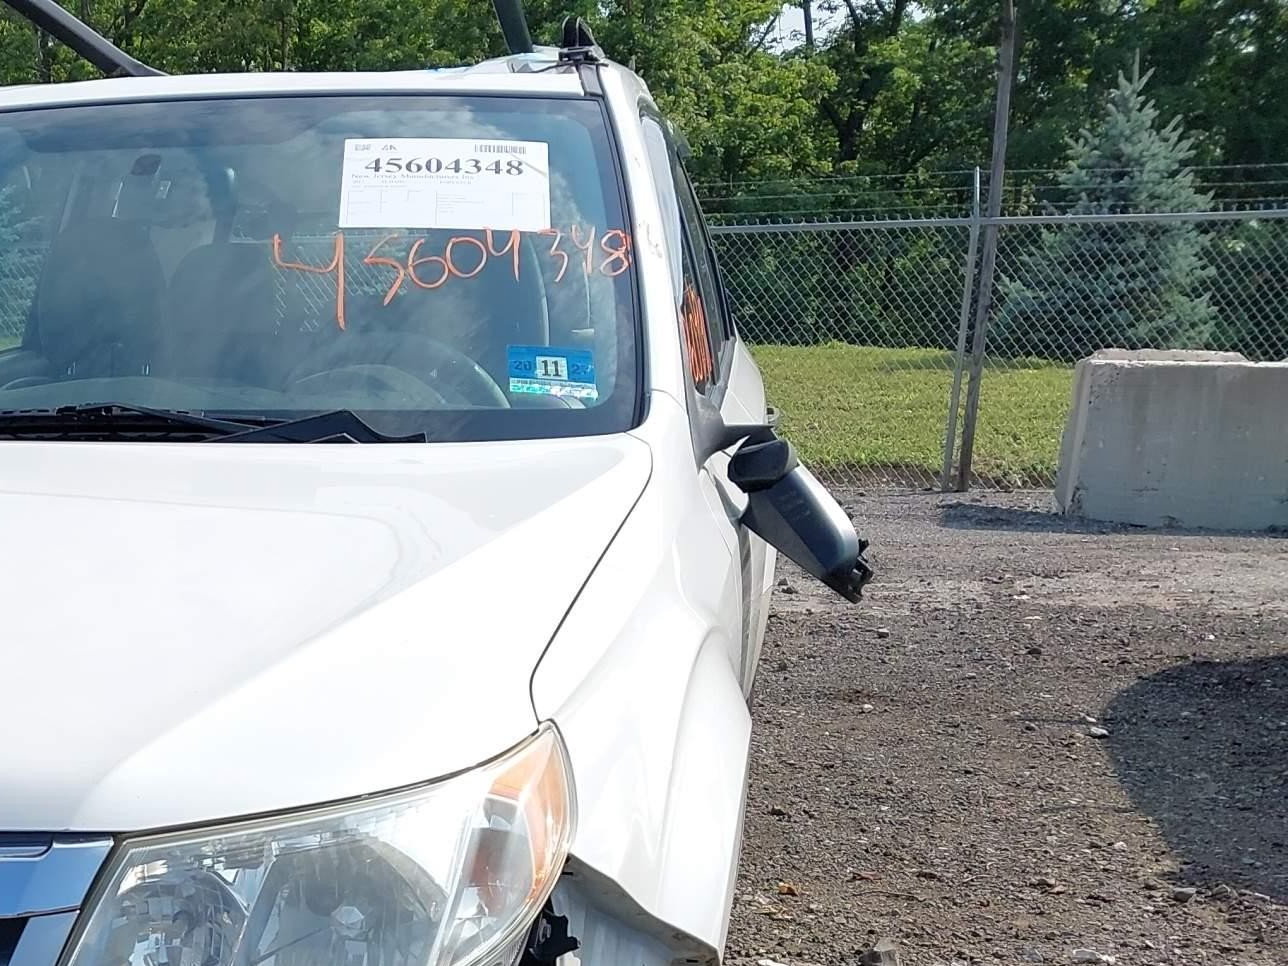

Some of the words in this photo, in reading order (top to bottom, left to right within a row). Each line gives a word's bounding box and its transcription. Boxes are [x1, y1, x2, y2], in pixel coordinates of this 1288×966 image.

[365, 157, 524, 176] 45604348
[272, 224, 630, 330] 45604348
[541, 359, 562, 377] 11
